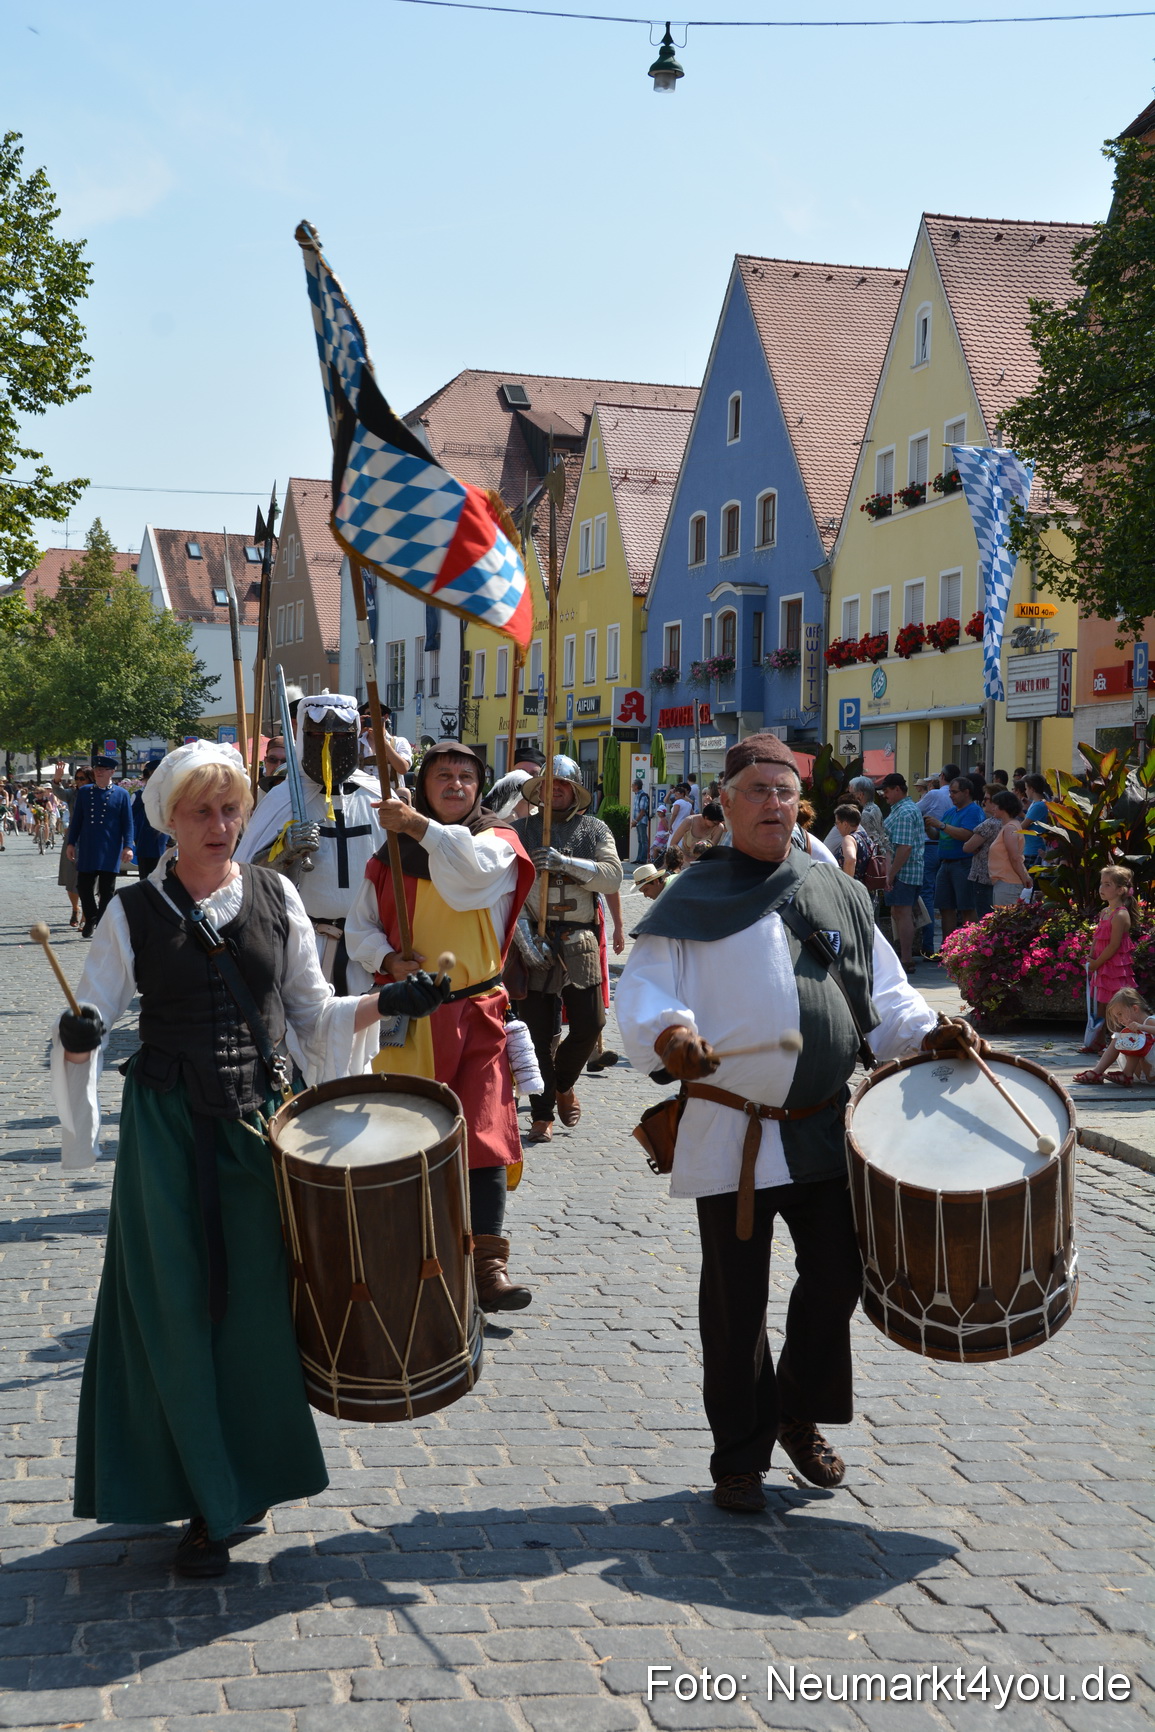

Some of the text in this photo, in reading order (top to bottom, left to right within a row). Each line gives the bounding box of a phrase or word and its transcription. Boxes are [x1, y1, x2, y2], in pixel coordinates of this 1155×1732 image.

[1020, 605, 1040, 616] KINO
[1136, 648, 1146, 682] P
[1015, 677, 1050, 693] RIALTO KINO
[1061, 652, 1070, 712] KINO
[567, 697, 573, 718] P
[843, 702, 856, 728] P
